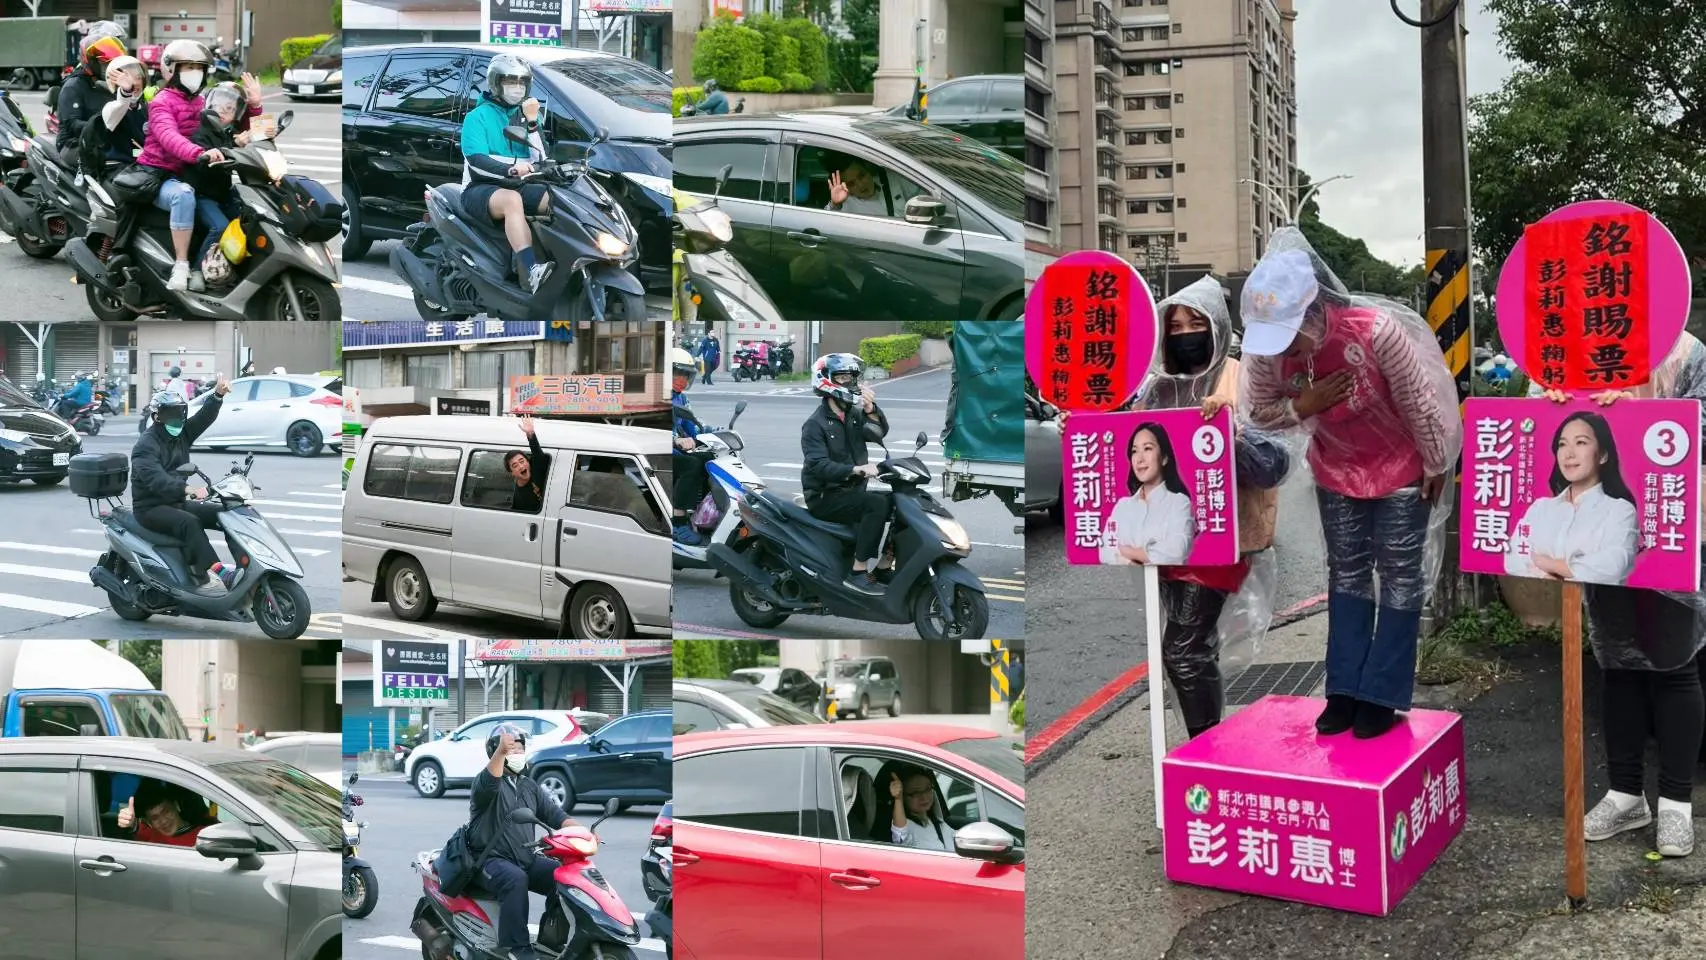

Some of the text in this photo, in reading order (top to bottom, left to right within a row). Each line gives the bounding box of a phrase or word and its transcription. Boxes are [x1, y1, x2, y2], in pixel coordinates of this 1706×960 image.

[492, 23, 559, 38] FELLA
[1582, 219, 1635, 384] 銘謝賜票
[1081, 269, 1119, 405] 銘謝賜票
[542, 377, 622, 395] 三尚汽車
[1201, 431, 1216, 456] 3
[1656, 428, 1676, 458] 3
[1071, 432, 1104, 548] 彭莉惠
[1206, 468, 1226, 533] 彭博士
[1472, 416, 1514, 553] 彭莉惠
[1644, 472, 1659, 549] 有莉惠做事
[1660, 472, 1686, 552] 彭博士
[1518, 523, 1531, 556] 博士
[491, 648, 520, 656] RACING
[384, 674, 446, 687] FELLA
[386, 687, 445, 699] DESIGN
[1410, 758, 1460, 847] 彭莉惠
[1186, 818, 1335, 886] 彭莉惠
[1338, 847, 1357, 888] 博士
